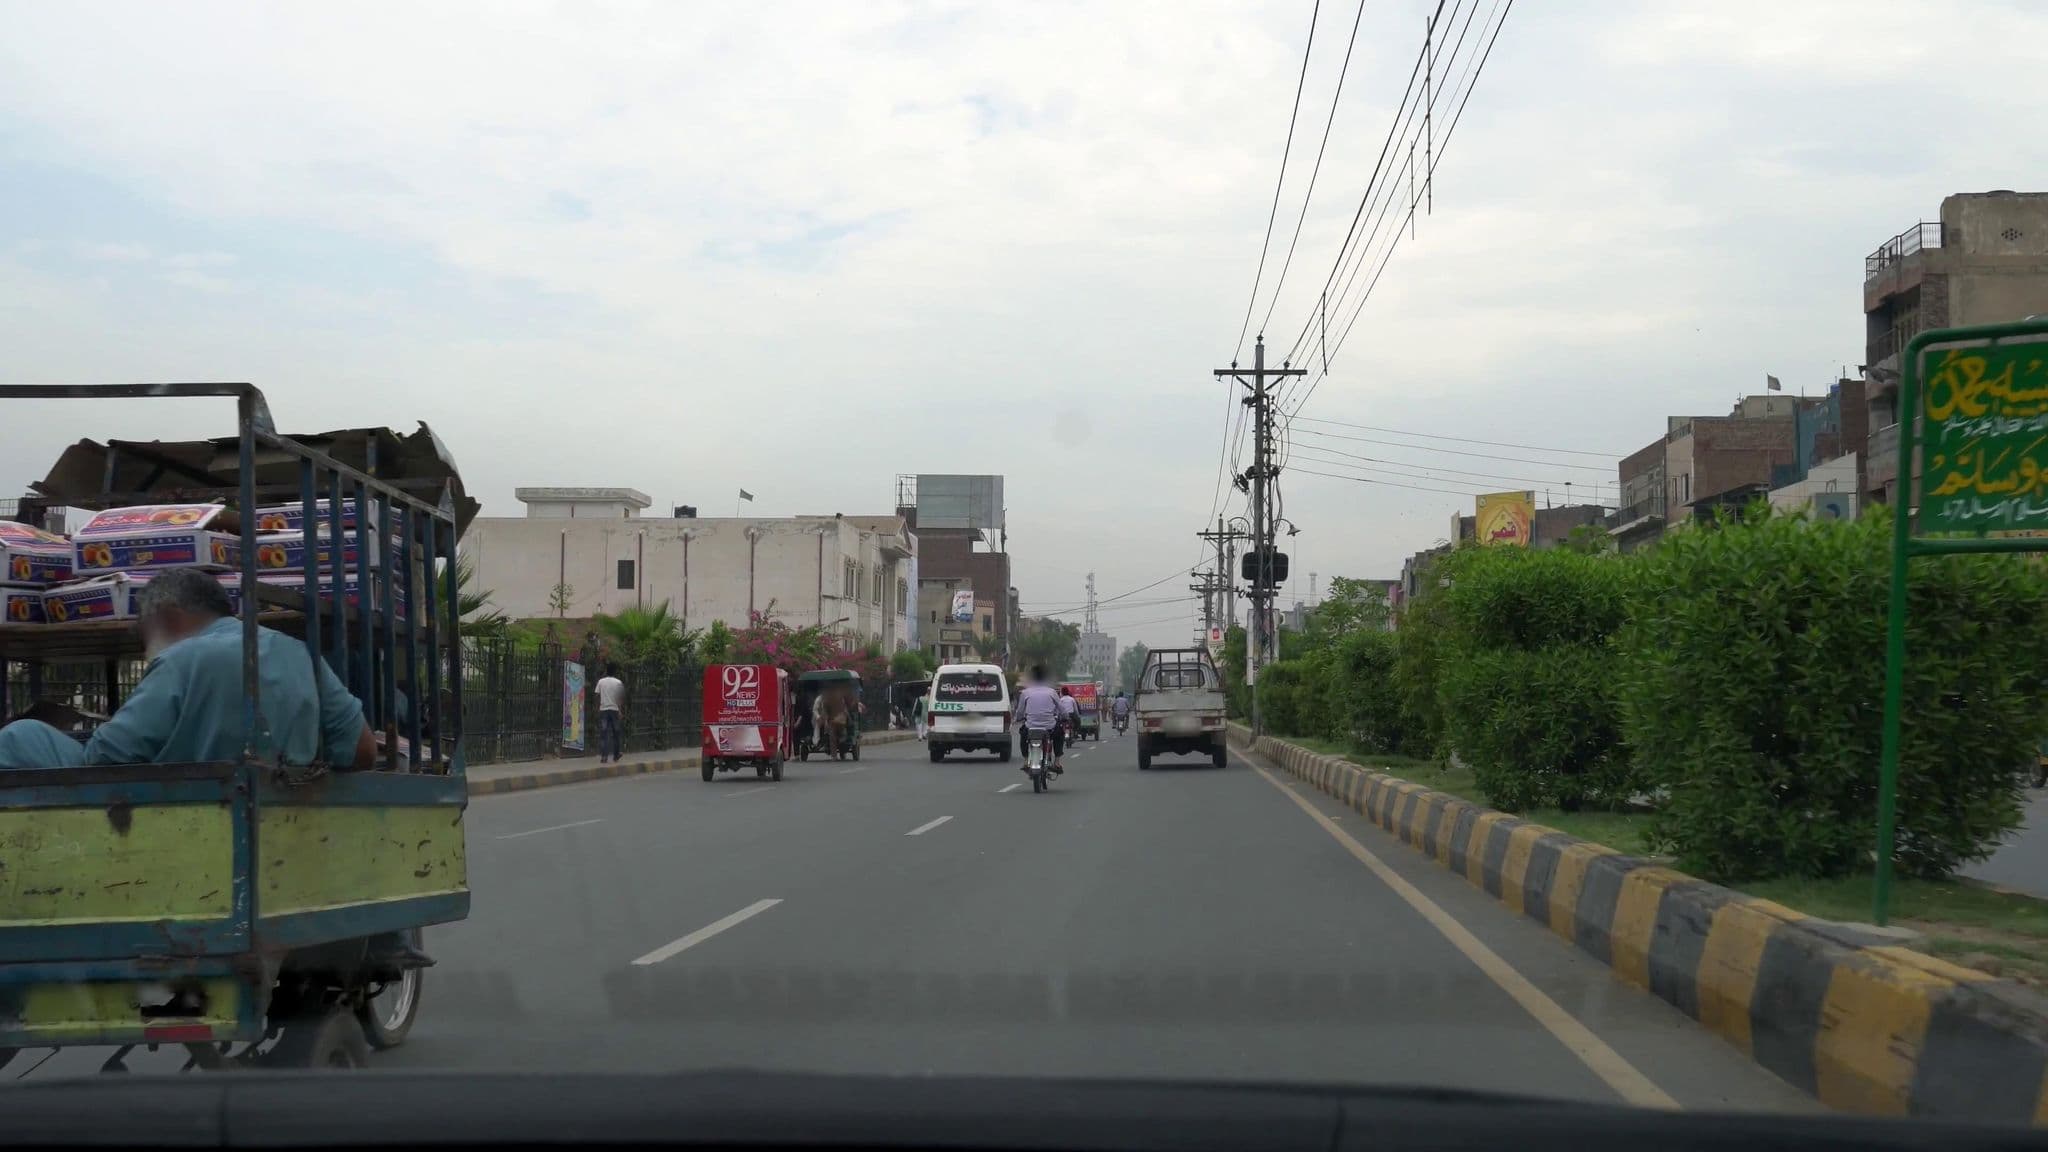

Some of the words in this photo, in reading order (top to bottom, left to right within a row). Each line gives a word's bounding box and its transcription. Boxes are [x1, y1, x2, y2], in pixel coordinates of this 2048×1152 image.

[723, 666, 758, 697] 92
[736, 691, 757, 699] NEWS
[933, 702, 964, 711] FUTS
